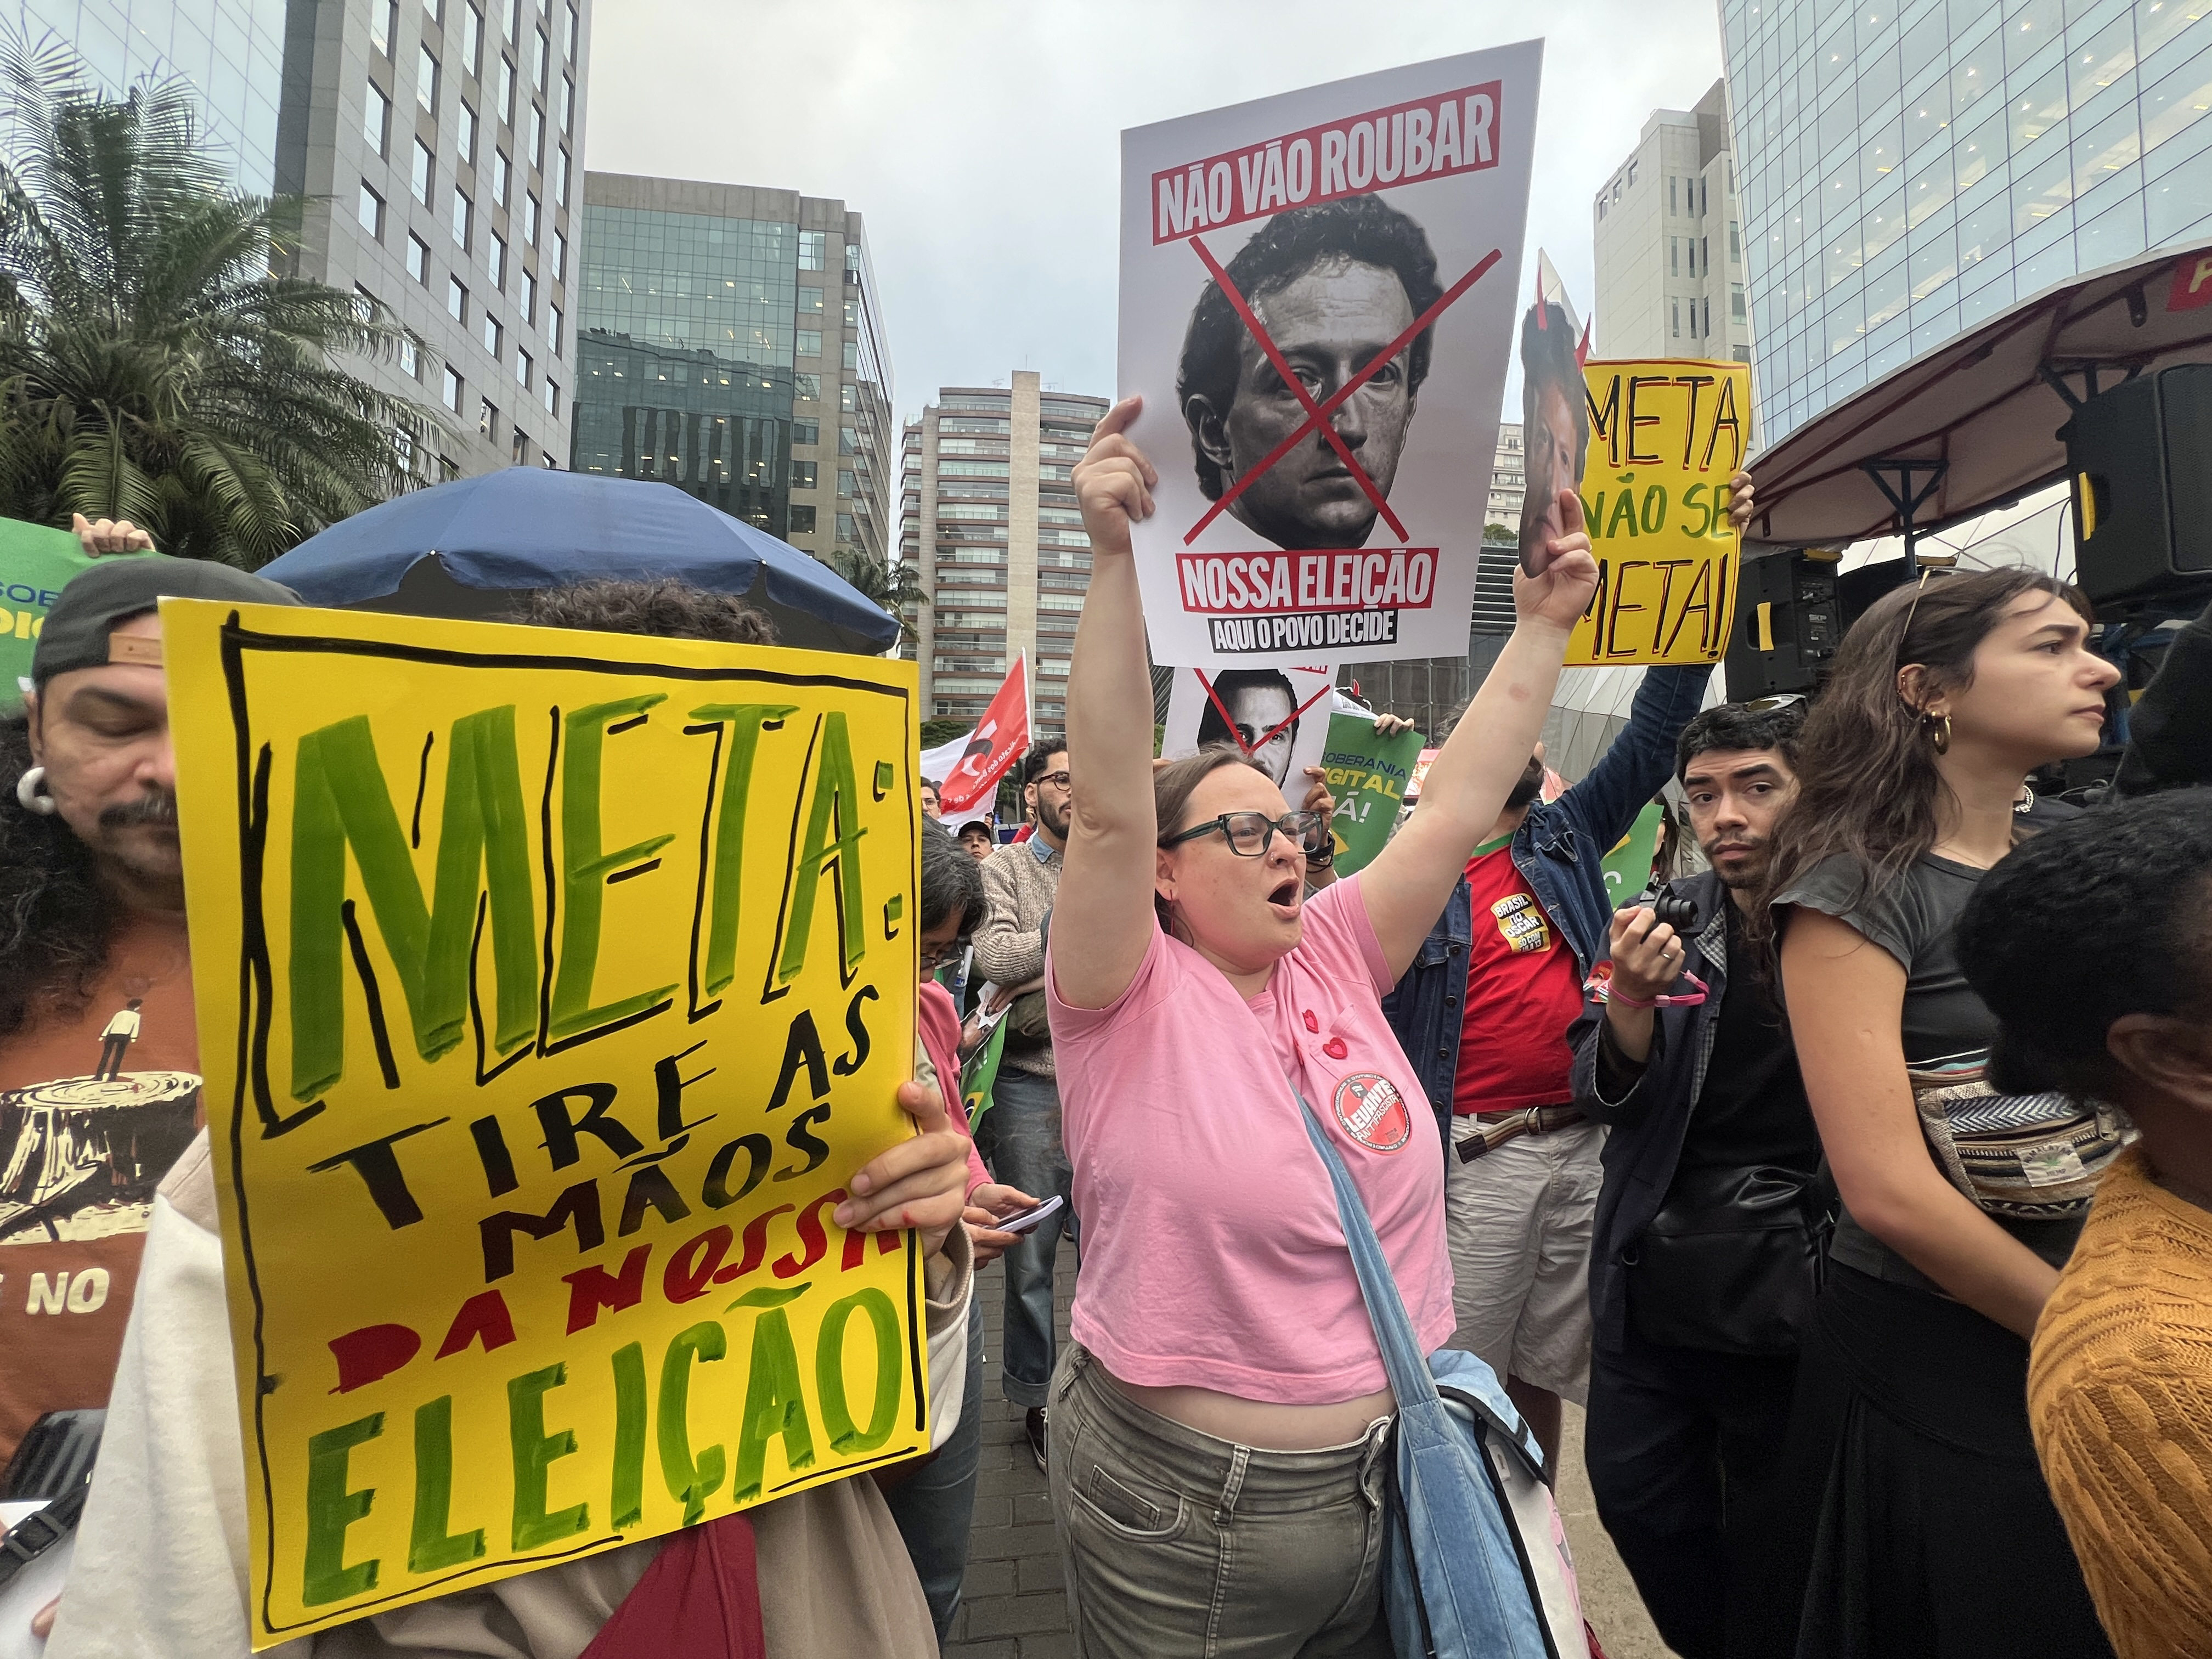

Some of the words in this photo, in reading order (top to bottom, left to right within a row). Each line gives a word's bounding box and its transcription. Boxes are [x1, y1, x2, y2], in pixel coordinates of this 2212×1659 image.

[1158, 163, 1232, 238] NÃO
[1238, 140, 1312, 215] VÃO
[1321, 93, 1494, 196] ROUBAR
[1585, 374, 1740, 472] META
[1579, 472, 1667, 539] NÃO
[1681, 483, 1734, 539] SE
[1182, 556, 1293, 610] NOSSA
[1299, 550, 1432, 610] ELEIÇÃO
[1214, 619, 1256, 651] AQUI
[1258, 618, 1269, 648] O
[1273, 615, 1324, 648] POVO
[1327, 611, 1393, 645] DECIDE
[1331, 791, 1371, 823] Á!
[258, 692, 903, 1136] META:
[1493, 895, 1528, 918] BRASIL
[1504, 917, 1539, 938] OSCAR
[307, 1040, 716, 1230] TIRE
[765, 985, 879, 1113] AS
[1344, 1079, 1394, 1133] LEVANTE
[1356, 1094, 1400, 1139] ANTIFASCISTA
[477, 1102, 831, 1283] MÃOS
[25, 1268, 110, 1315] NO
[329, 1290, 517, 1395] DA
[303, 1282, 903, 1609] ELEIÇÃO
